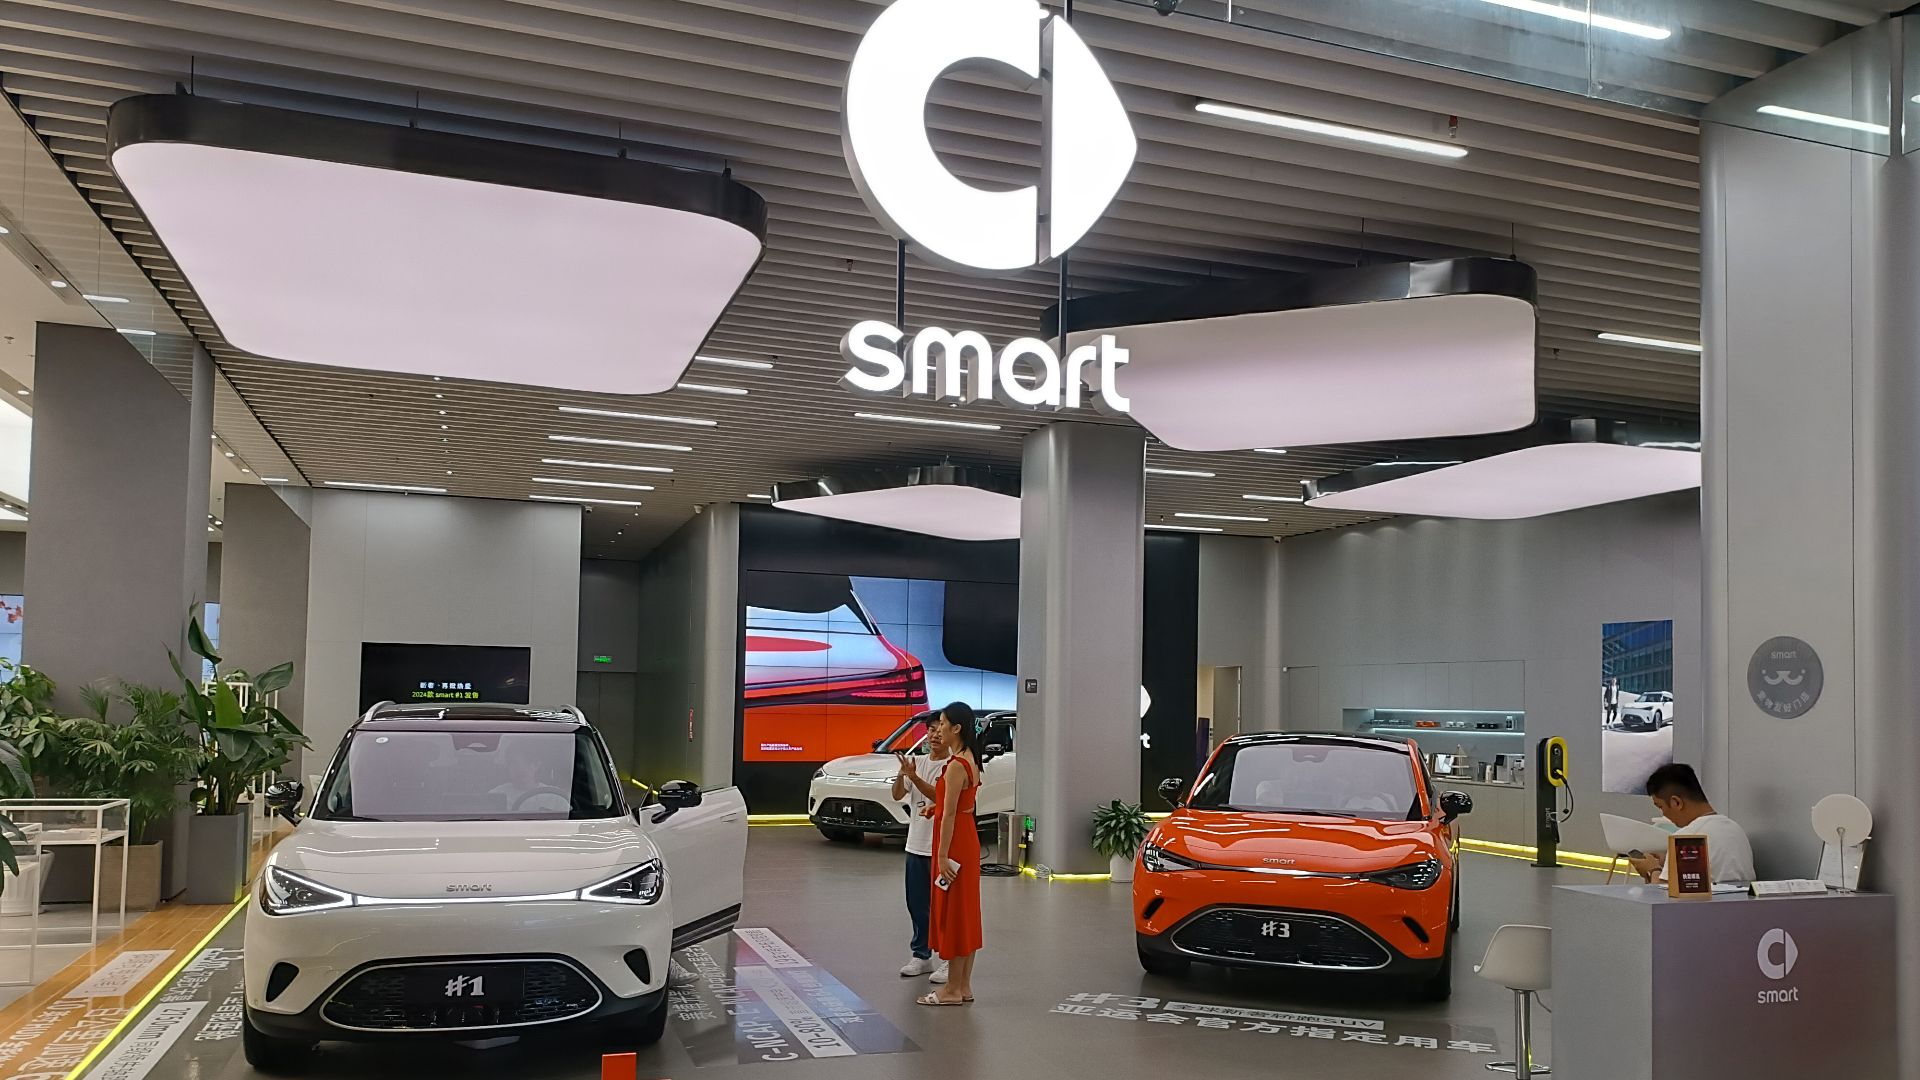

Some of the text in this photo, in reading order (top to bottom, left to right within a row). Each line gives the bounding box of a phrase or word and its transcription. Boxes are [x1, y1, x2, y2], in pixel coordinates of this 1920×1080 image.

[843, 320, 1130, 413] smart
[1771, 651, 1797, 659] smart
[1263, 857, 1296, 865] smart
[445, 883, 493, 893] smart
[1260, 920, 1291, 939] #3
[444, 974, 485, 997] #1
[1065, 992, 1163, 1010] #3
[1757, 986, 1799, 1005] smart
[790, 1016, 842, 1050] 10-80%
[1049, 1003, 1497, 1054] 亚运会官方指定用车
